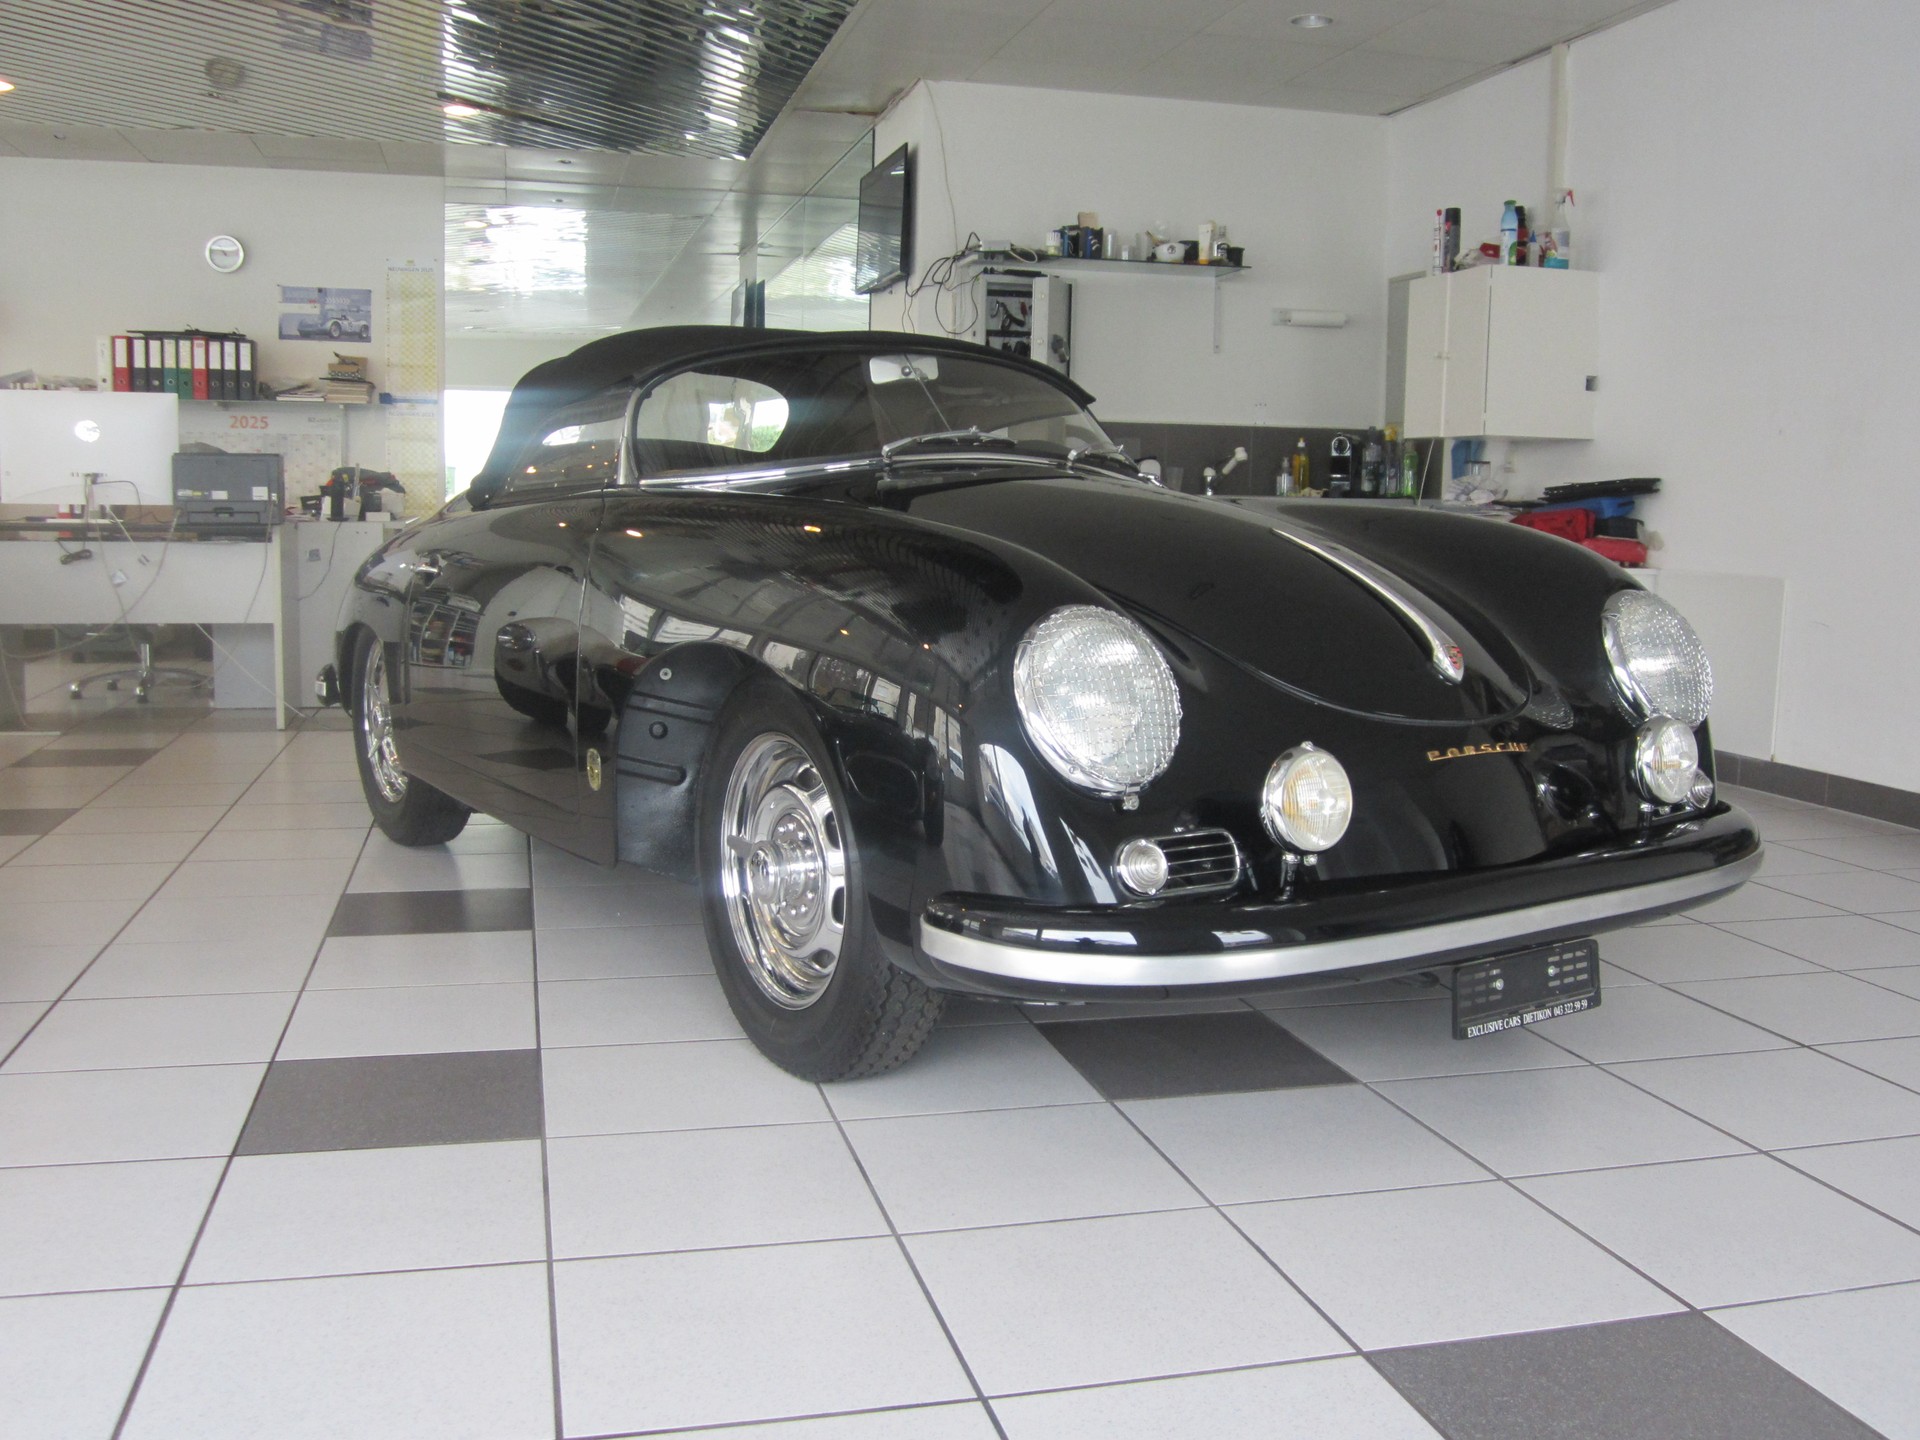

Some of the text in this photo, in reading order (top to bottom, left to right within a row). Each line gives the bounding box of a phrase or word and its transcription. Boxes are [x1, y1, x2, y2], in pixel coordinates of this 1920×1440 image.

[229, 415, 269, 429] 2025
[1427, 743, 1528, 761] PORSCHE
[1467, 999, 1588, 1038] EXCLUSIVE CARS DIETIKON 043 322 59 59
